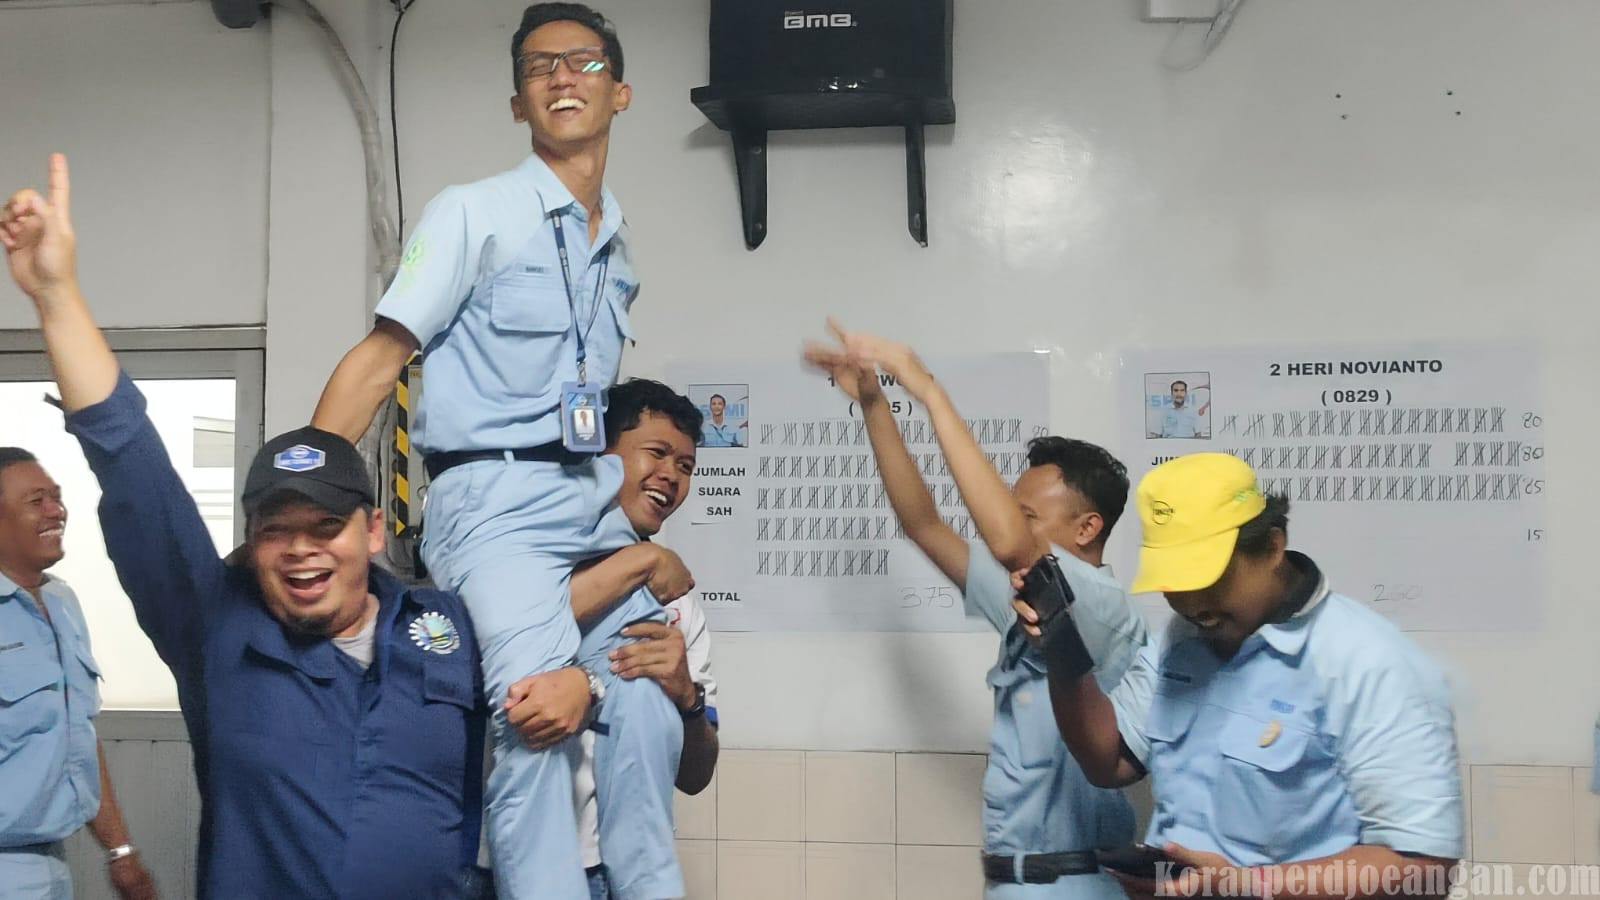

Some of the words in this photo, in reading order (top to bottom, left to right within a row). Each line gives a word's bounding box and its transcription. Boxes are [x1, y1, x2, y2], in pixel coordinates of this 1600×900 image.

[1269, 363, 1281, 376] 2
[1287, 362, 1333, 376] HERI
[1340, 359, 1443, 375] NOVIANTO
[1333, 390, 1380, 403] 0829
[693, 467, 746, 477] JUMLAH
[698, 487, 741, 497] SUARA
[706, 506, 732, 516] SAH
[1527, 528, 1544, 541] 15
[701, 592, 741, 602] TOTAL
[899, 586, 955, 609] 375
